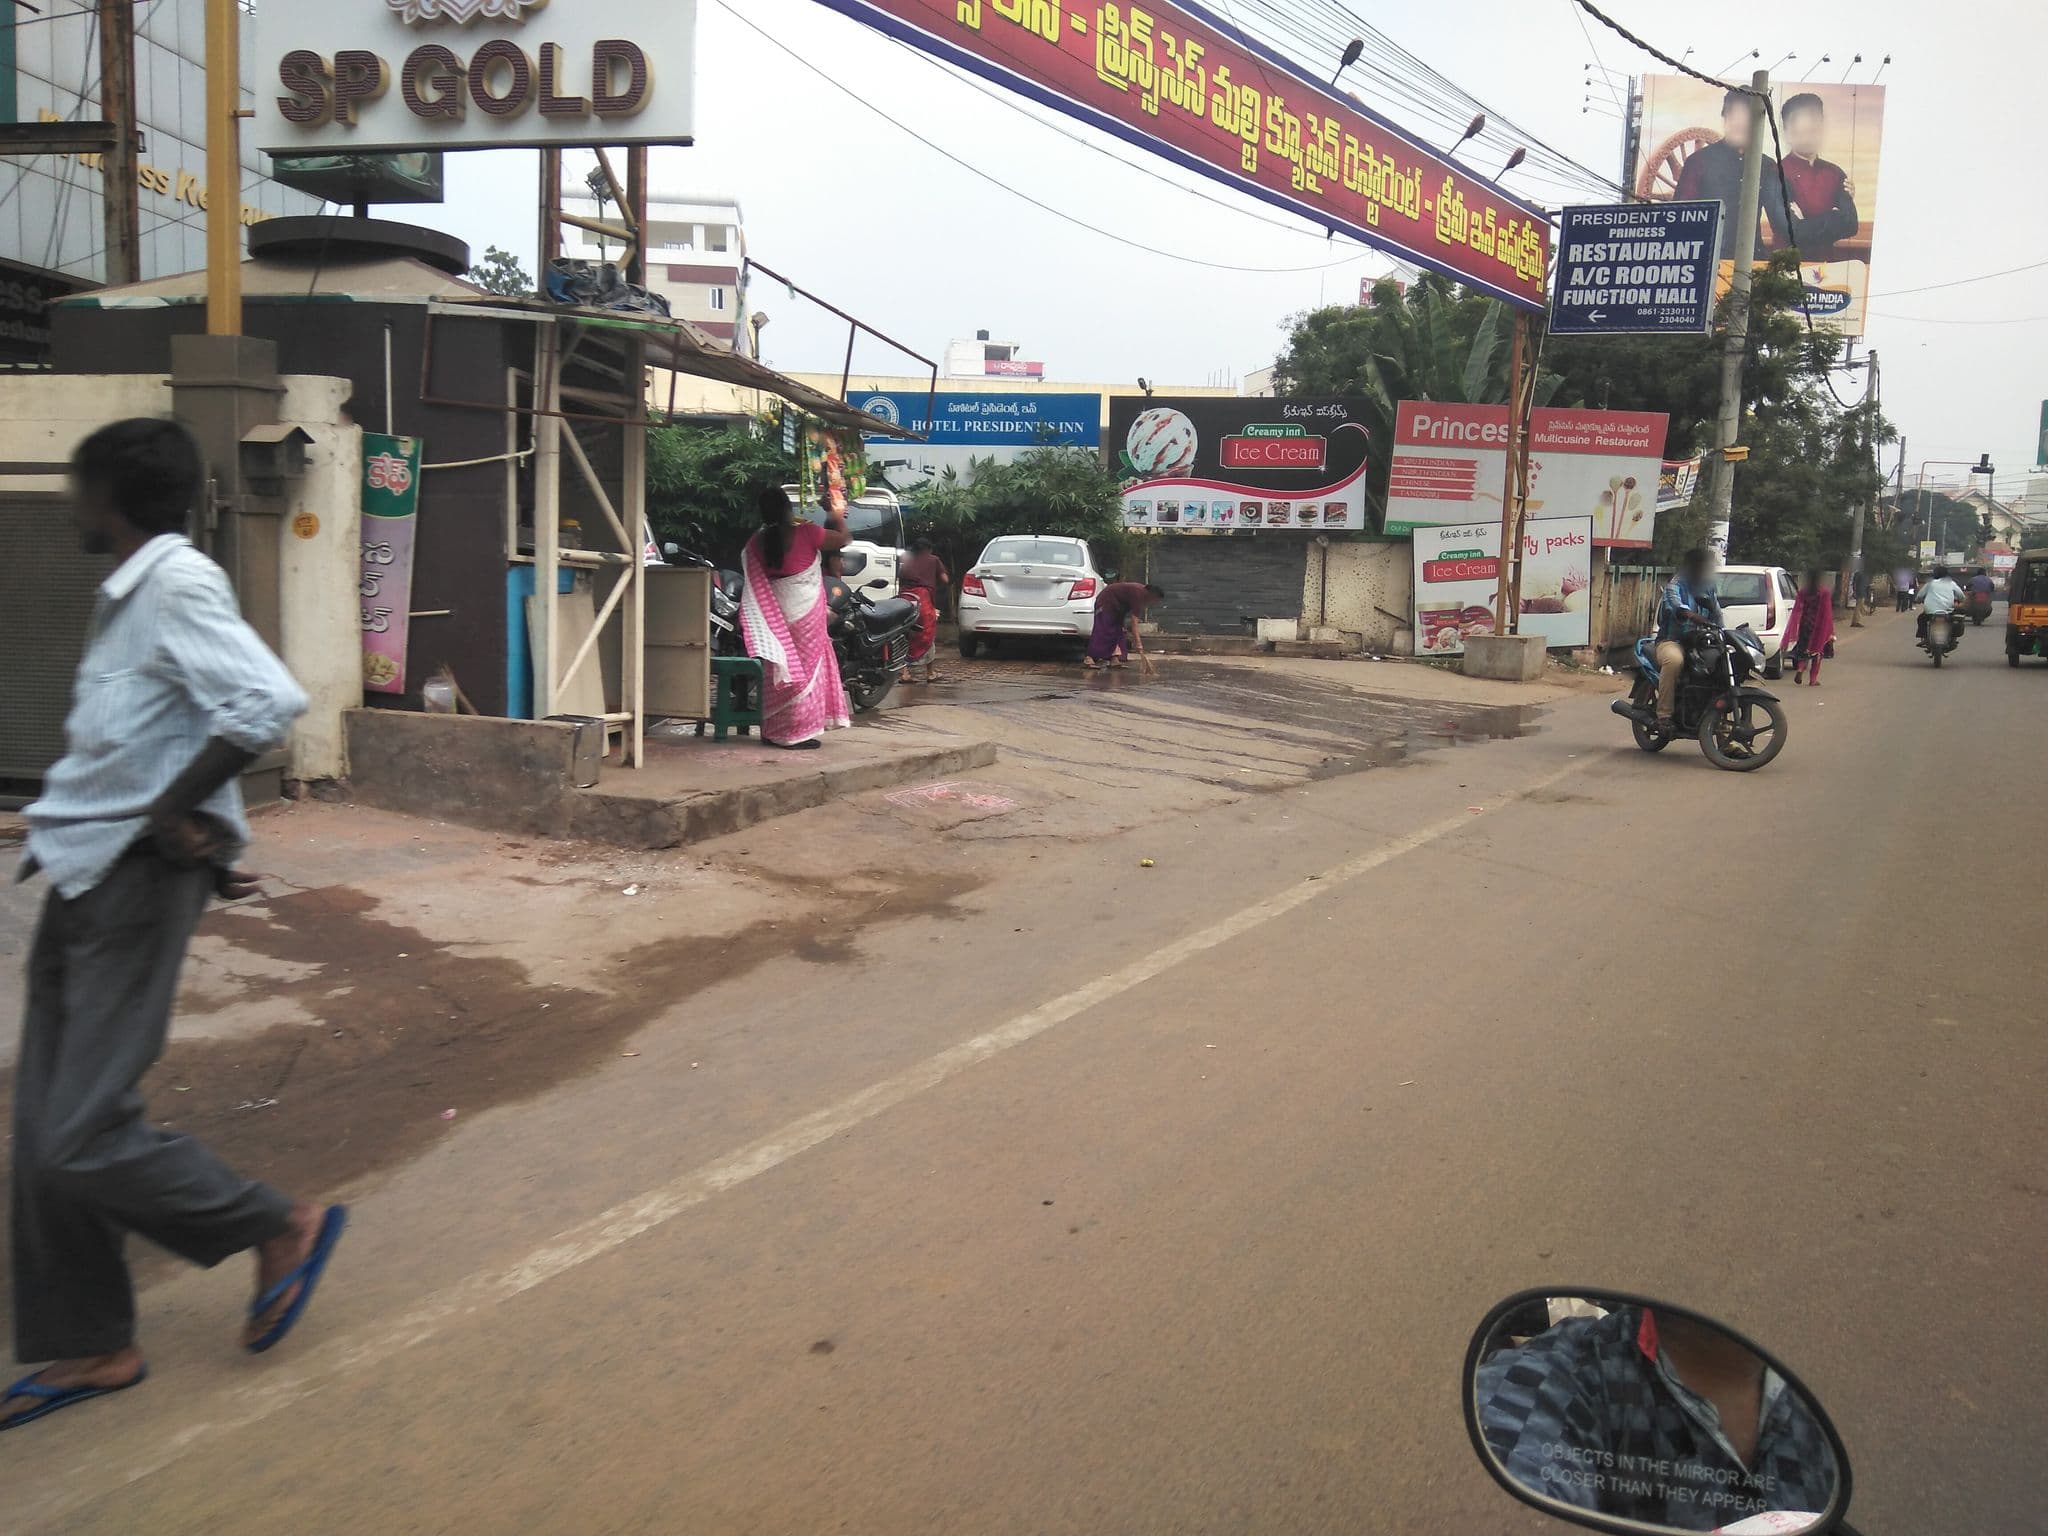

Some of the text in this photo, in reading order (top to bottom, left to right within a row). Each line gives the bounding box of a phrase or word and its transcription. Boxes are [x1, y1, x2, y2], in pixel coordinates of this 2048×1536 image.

[277, 39, 654, 126] SP GOLD
[1681, 210, 1709, 223] INN
[1609, 227, 1666, 238] PRINCESS
[1568, 241, 1704, 262] RESTAURANT
[1570, 265, 1695, 286] A/C ROOMS
[1563, 288, 1698, 306] FUNCTION HALL
[1819, 293, 1844, 304] INDIA
[1659, 316, 1695, 324] 2304040
[912, 420, 961, 432] HOTEL
[1059, 421, 1084, 433] INN
[1247, 427, 1301, 438] Creamy inn
[1535, 433, 1649, 448] Multicusine Restaurant
[1235, 443, 1319, 460] Ice Cream
[1429, 459, 1456, 467] INDIAN
[1546, 532, 1585, 554] packs
[1441, 551, 1481, 561] Creamy inn
[1433, 563, 1496, 577] Ice Cream
[1540, 1442, 1776, 1491] OBJECTS IN THE MIRROR ARE
[1540, 1466, 1768, 1512] CLOSER THAN THEY APPEAR
